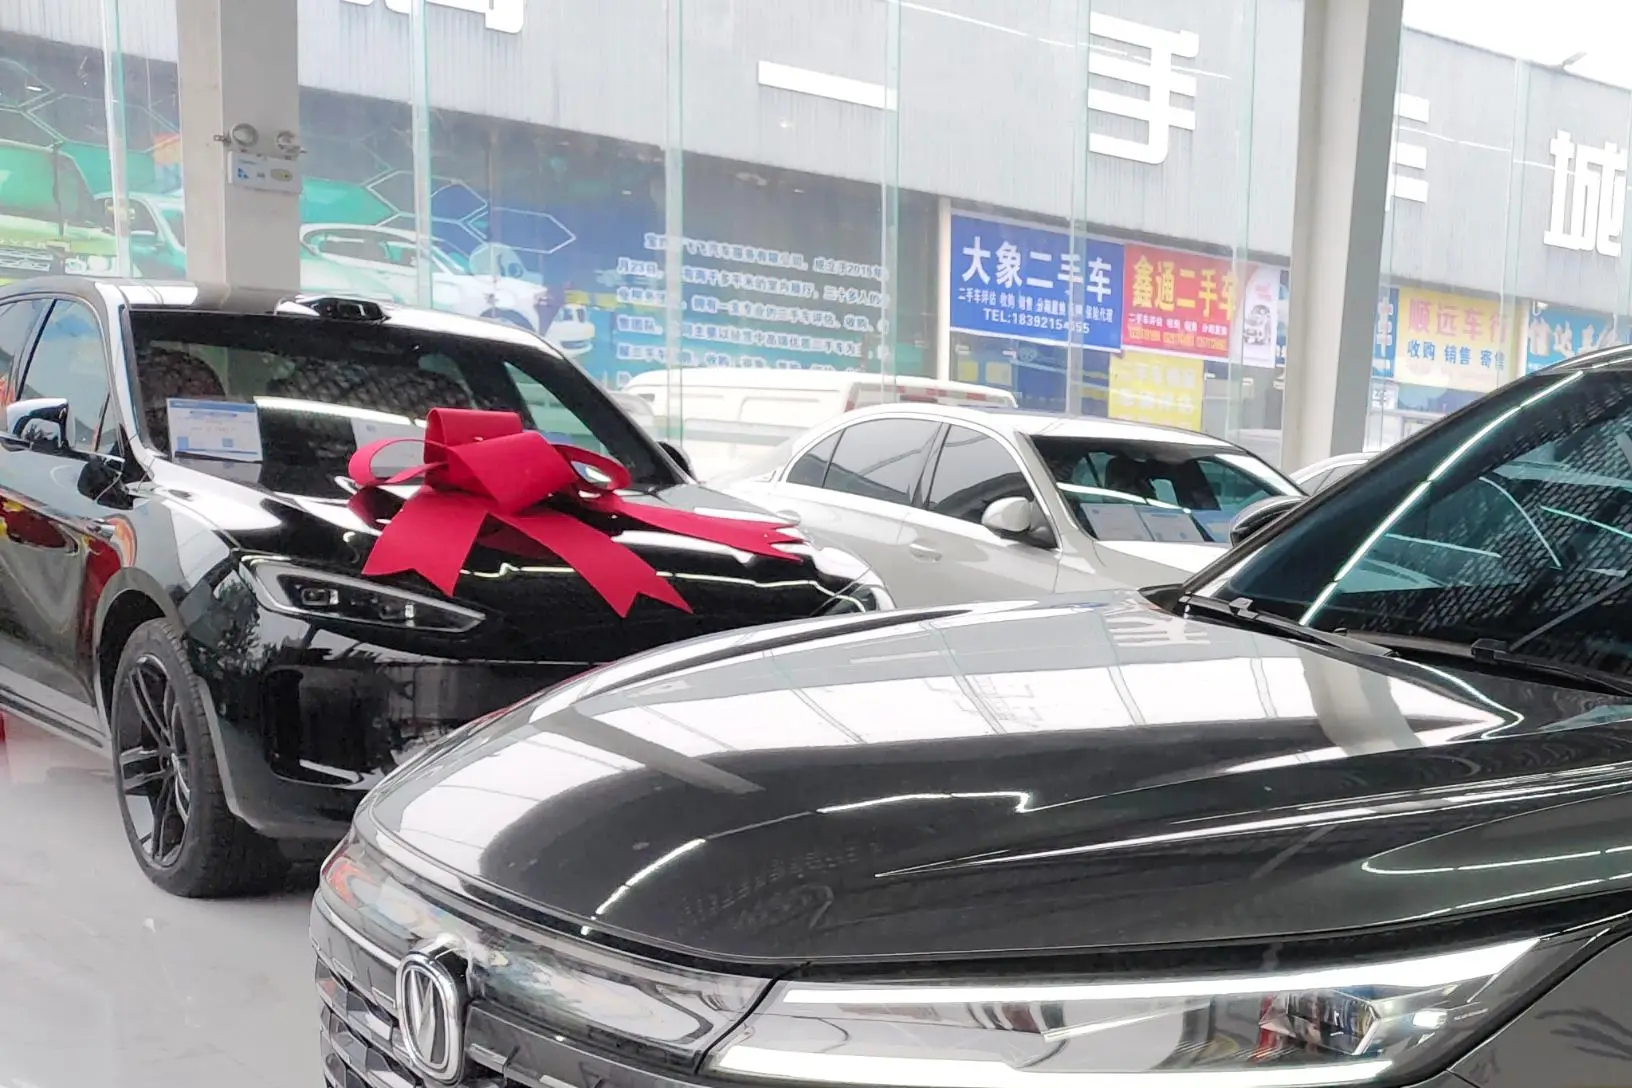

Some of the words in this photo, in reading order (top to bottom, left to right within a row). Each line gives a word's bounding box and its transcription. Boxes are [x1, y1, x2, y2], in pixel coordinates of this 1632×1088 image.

[962, 236, 1112, 303] 大象二手车
[1132, 255, 1238, 320] 鑫通二手车
[1408, 298, 1508, 343] 顺远车行
[1407, 340, 1435, 361] 收购
[1444, 345, 1472, 365] 销售
